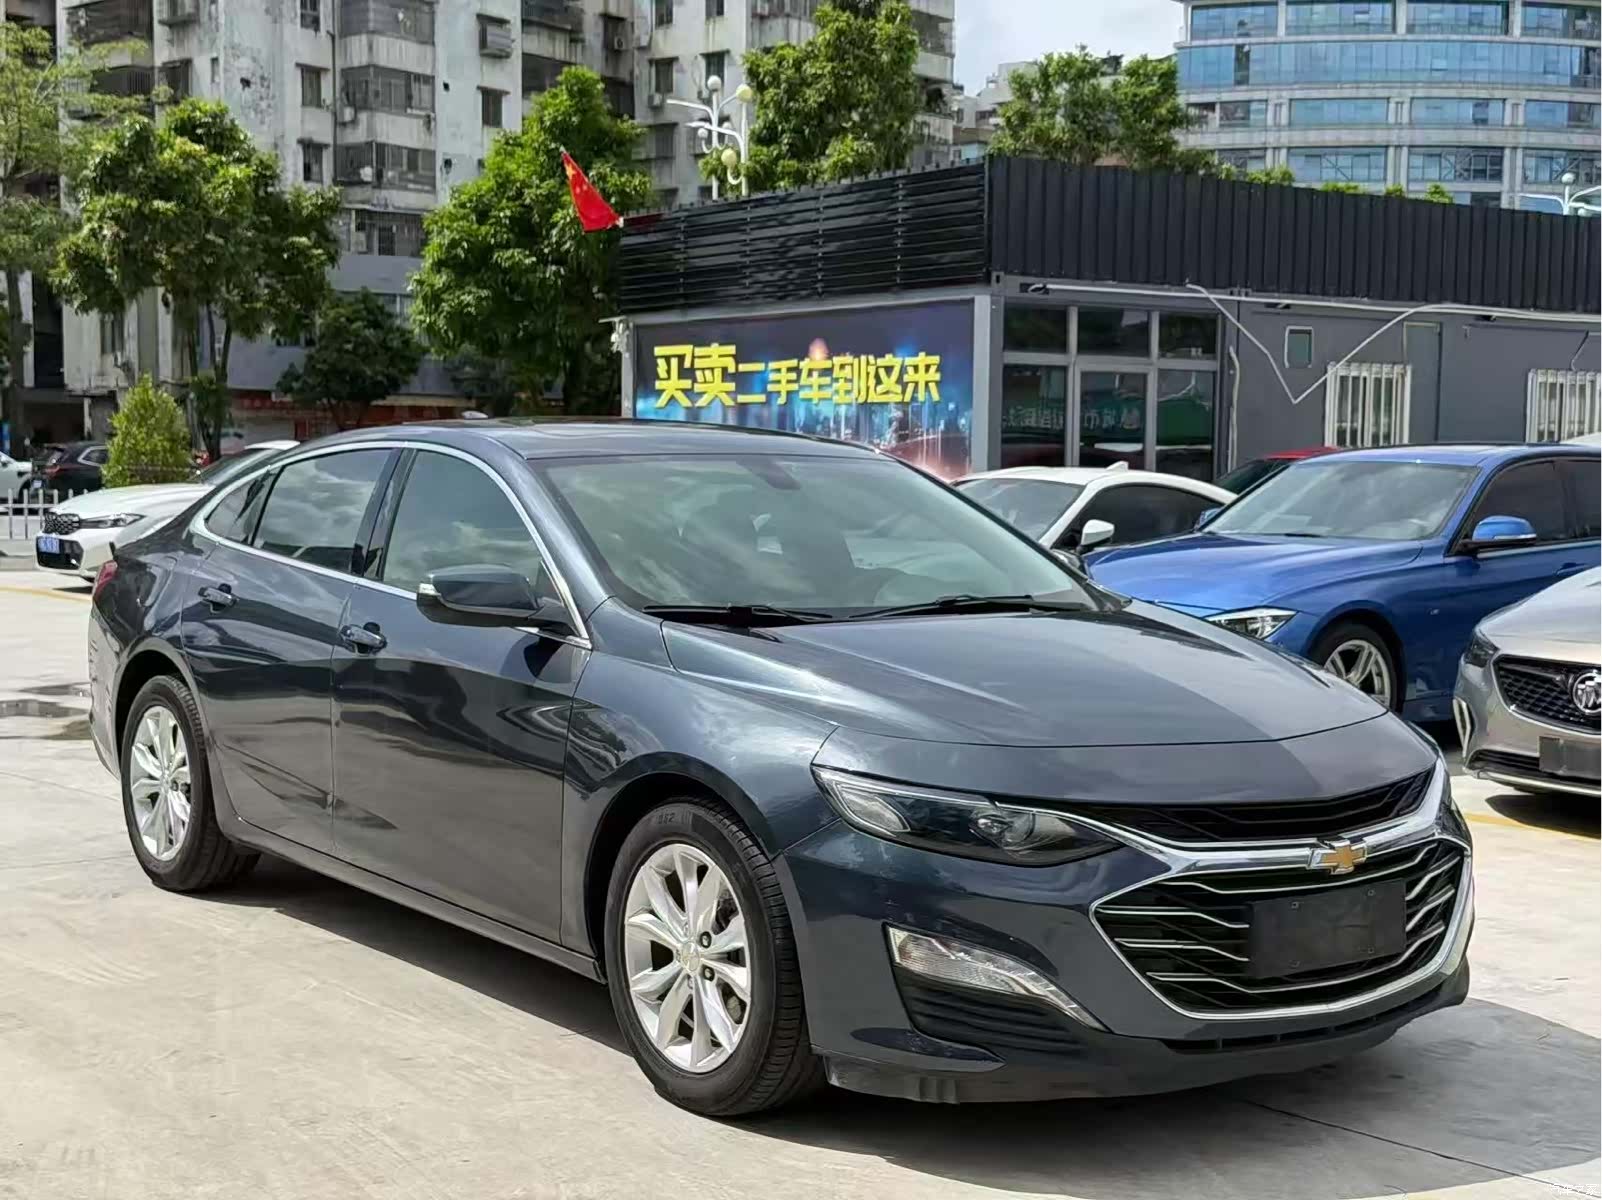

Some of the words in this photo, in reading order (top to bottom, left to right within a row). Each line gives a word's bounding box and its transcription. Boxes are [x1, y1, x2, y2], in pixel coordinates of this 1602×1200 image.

[653, 343, 941, 409] 买卖二手车到这来
